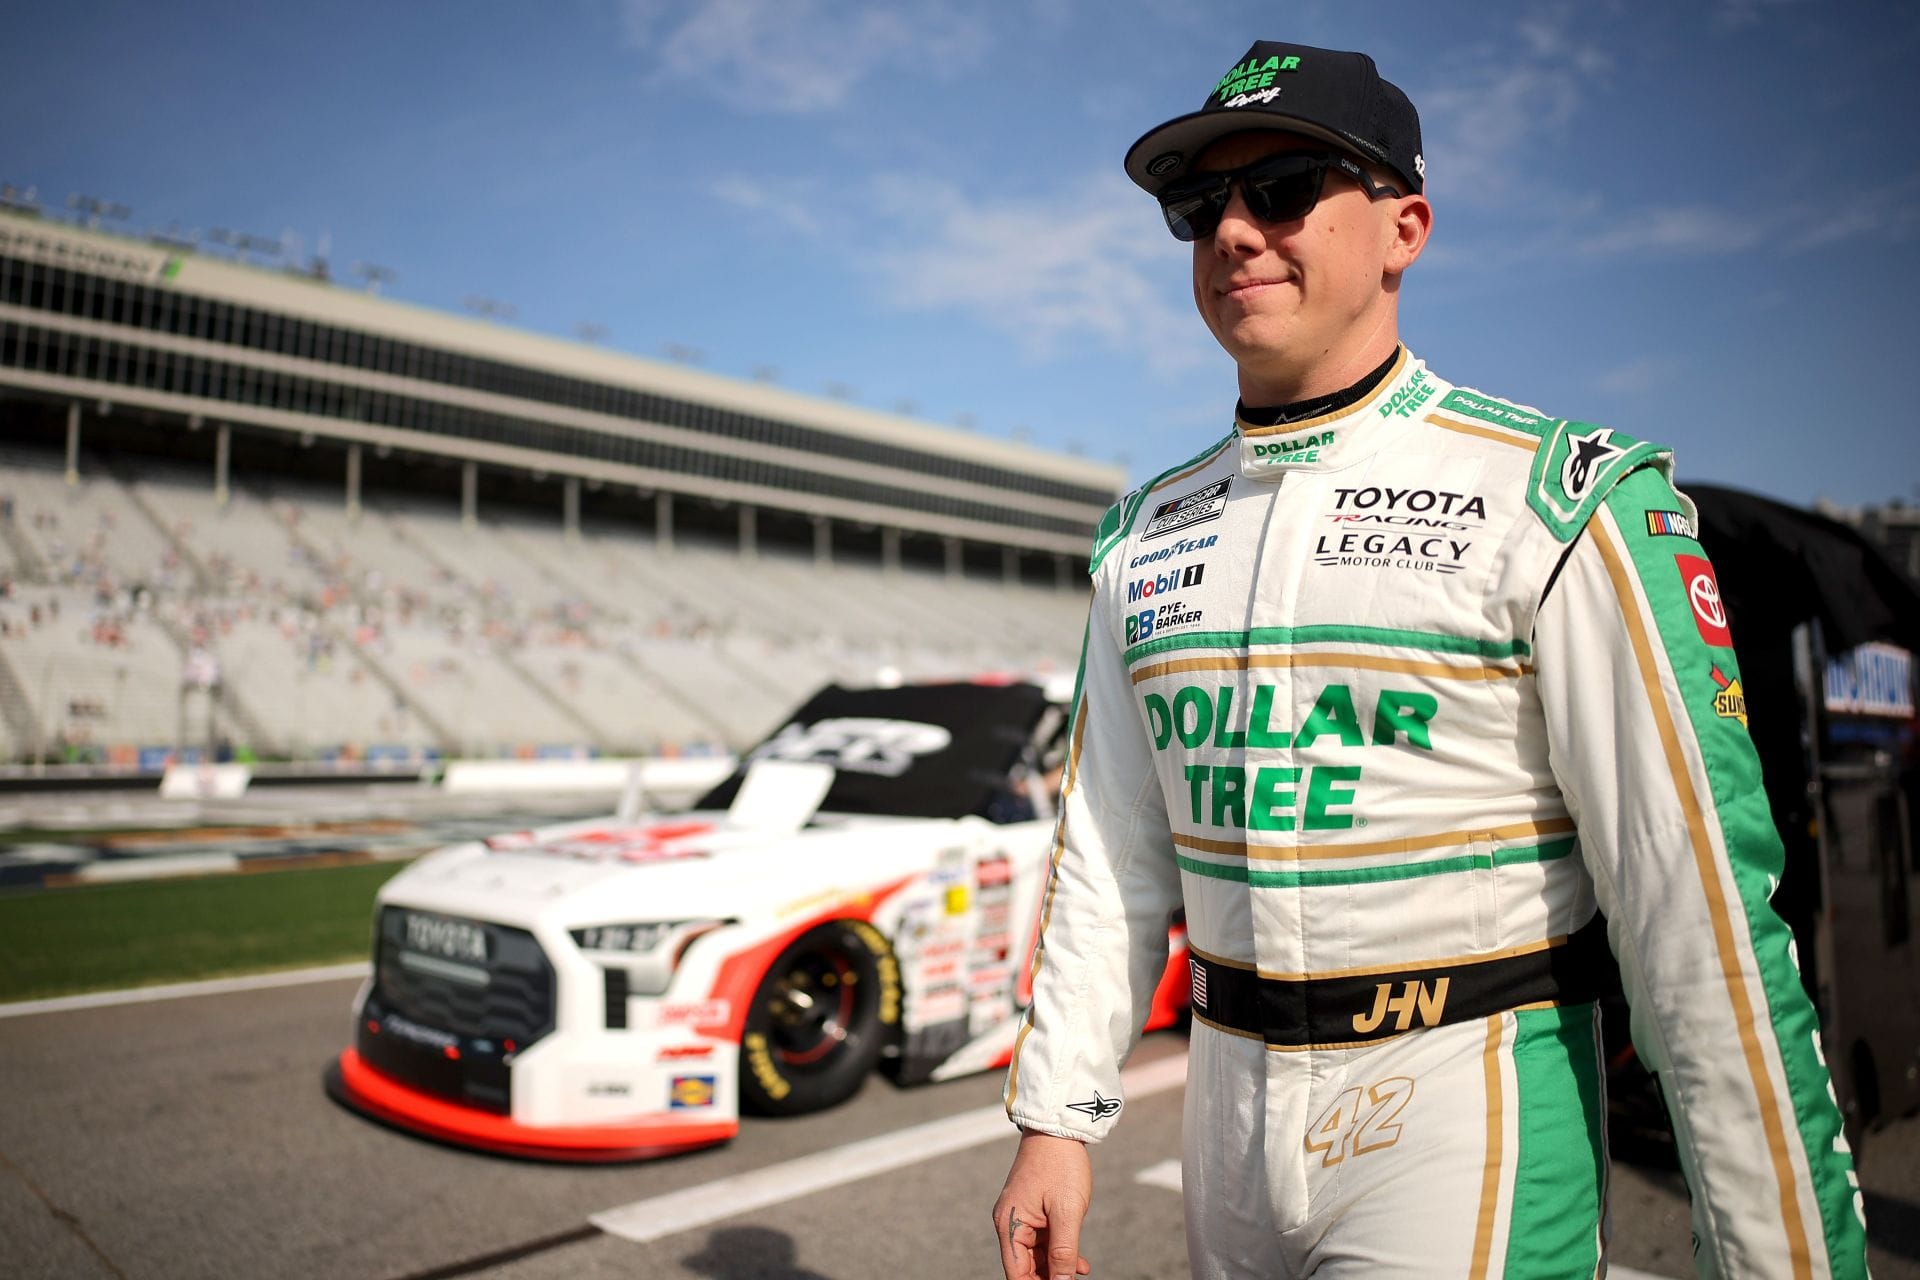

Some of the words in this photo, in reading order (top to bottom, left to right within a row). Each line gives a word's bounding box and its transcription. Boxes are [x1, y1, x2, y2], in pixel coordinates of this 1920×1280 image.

[1219, 71, 1277, 102] TREE
[1378, 368, 1428, 419] DOLLAR
[1396, 383, 1436, 419] TREE
[1452, 395, 1504, 417] DOLLAR
[1504, 411, 1539, 425] TREE
[1253, 430, 1335, 457] DOLLAR
[1267, 449, 1320, 465] TREE
[1178, 484, 1222, 511] NASCAR
[1334, 487, 1487, 520] TOYOTA
[1156, 513, 1179, 530] CUP
[1179, 500, 1216, 523] SERIES
[1331, 514, 1469, 531] RACING
[1129, 534, 1219, 569] GOODYEAR
[1315, 533, 1472, 561] LEGACY
[1339, 556, 1391, 568] MOTOR
[1396, 558, 1434, 571] CLUB
[1127, 568, 1182, 604] Mobil
[1155, 610, 1203, 630] BARKER
[1143, 684, 1439, 751] DOLLAR
[1184, 764, 1363, 832] TREE
[1352, 976, 1450, 1034] JHN
[1303, 1075, 1415, 1169] 42
